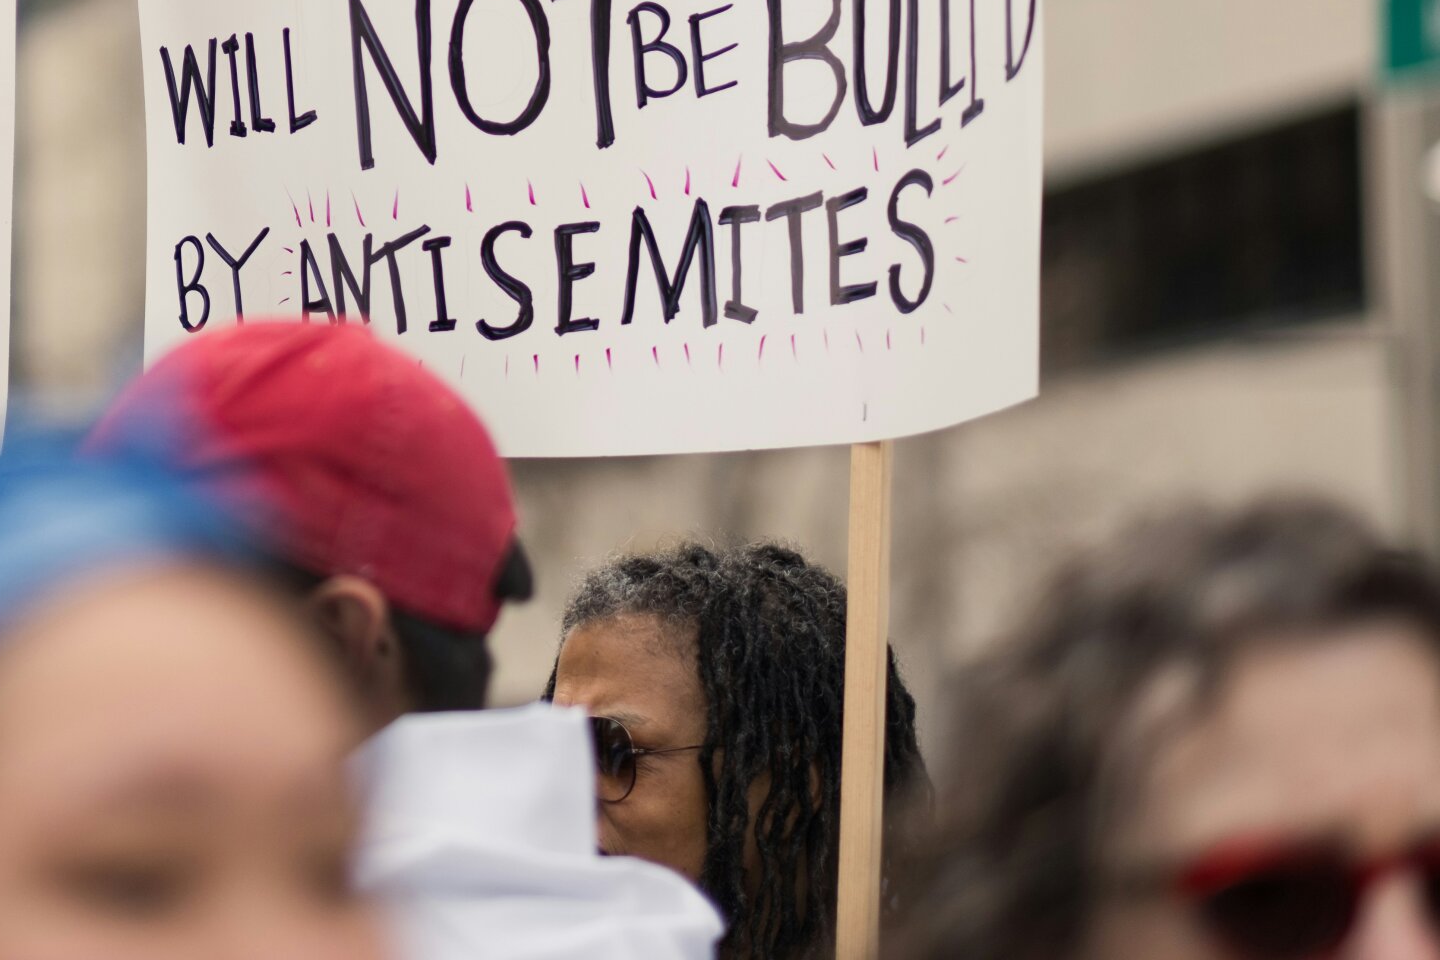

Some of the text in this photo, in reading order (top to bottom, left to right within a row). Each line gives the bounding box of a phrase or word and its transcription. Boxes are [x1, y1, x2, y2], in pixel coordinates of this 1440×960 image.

[160, 27, 317, 148] WILL
[626, 1, 739, 109] BE
[173, 167, 934, 341] BY ANTISEMITES
